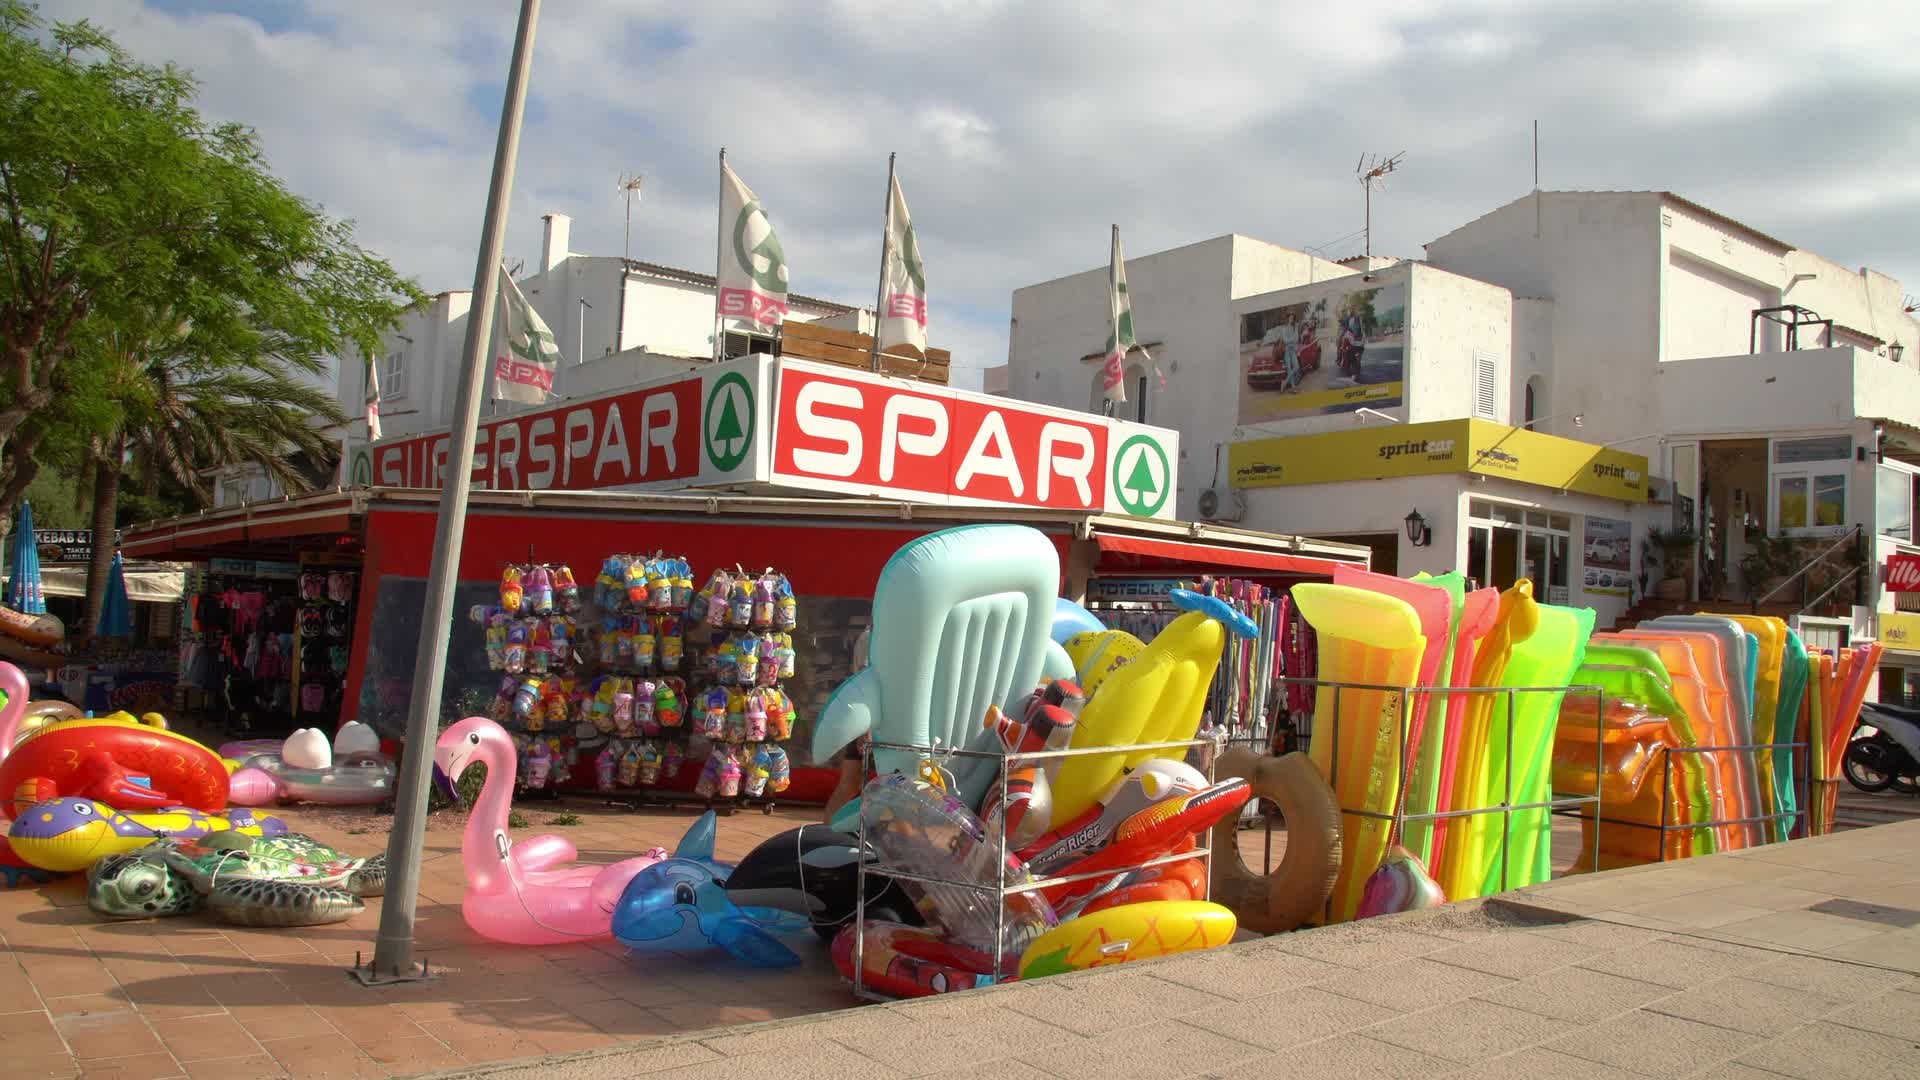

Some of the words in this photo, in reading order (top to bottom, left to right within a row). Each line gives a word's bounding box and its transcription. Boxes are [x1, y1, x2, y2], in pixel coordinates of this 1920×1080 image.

[724, 293, 780, 321] SPA
[500, 361, 548, 390] SPA
[792, 380, 1096, 507] SPAR
[1379, 439, 1455, 459] sprintcar
[1427, 452, 1453, 462] rental
[35, 532, 75, 543] KEBAB
[77, 532, 86, 543] &
[1889, 560, 1920, 590] illy
[1066, 823, 1100, 853] Rider
